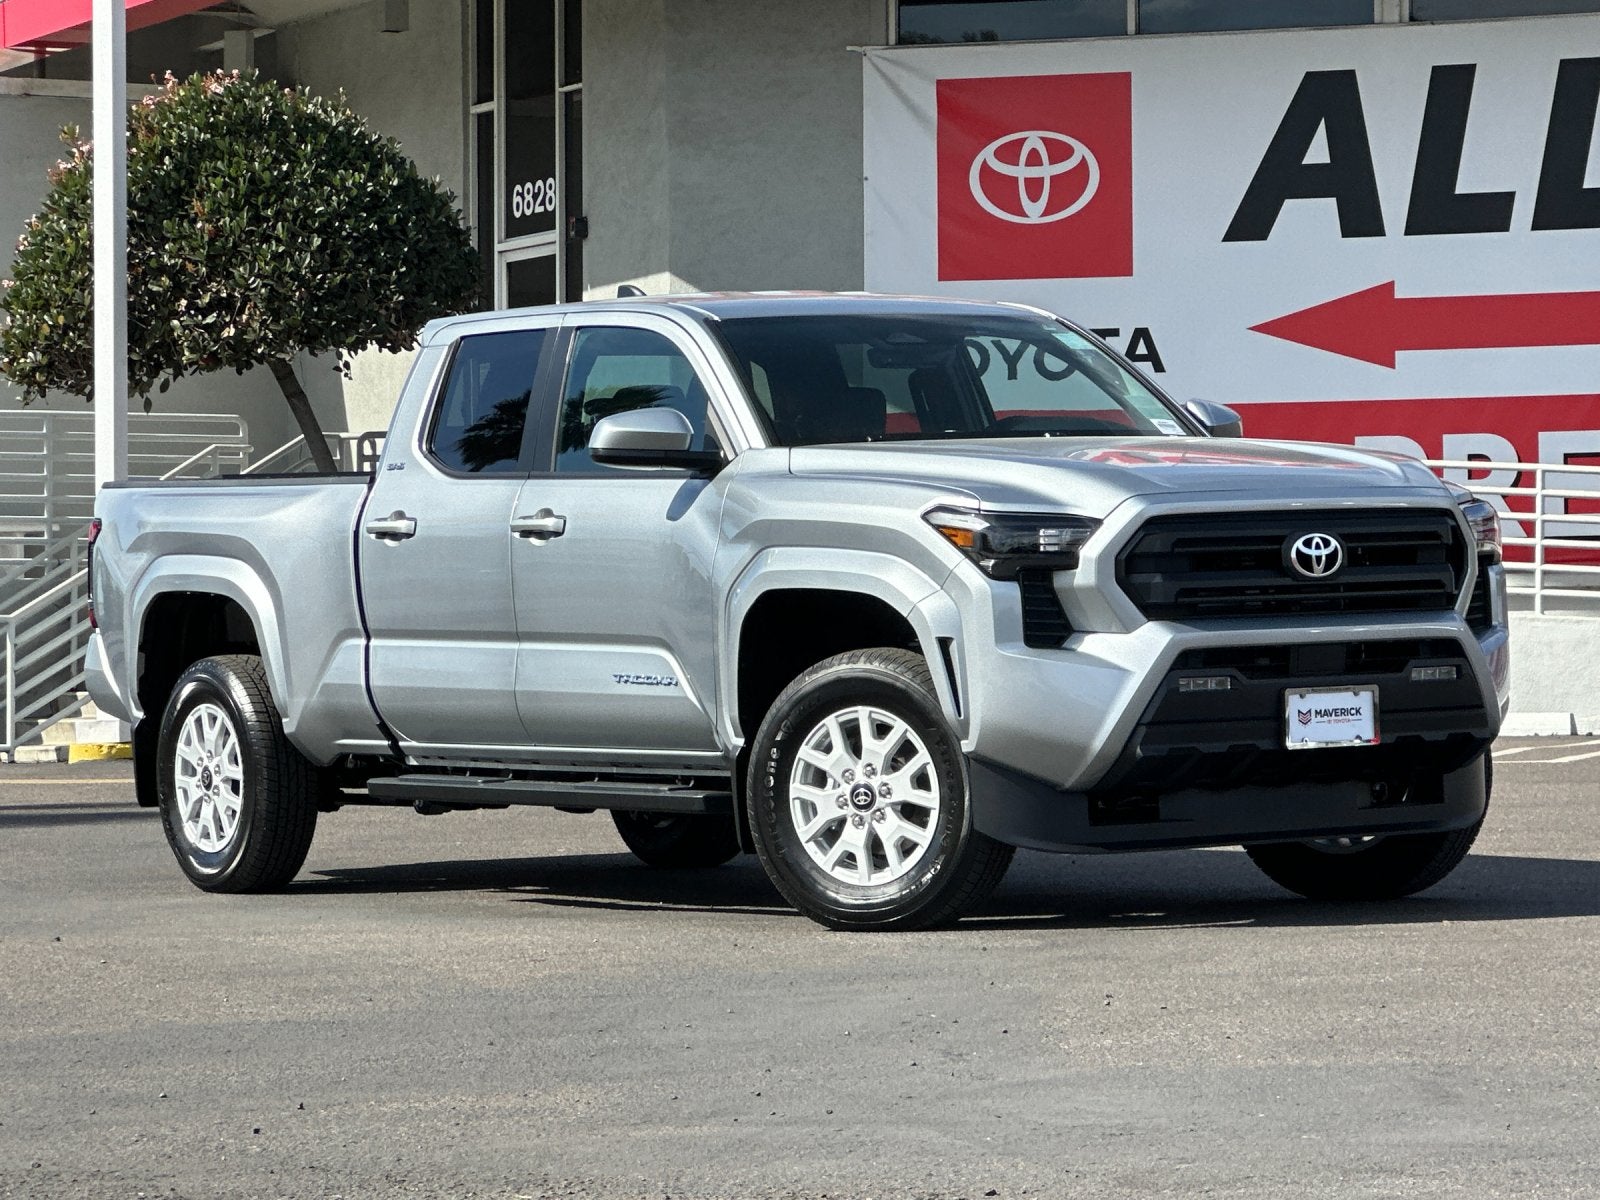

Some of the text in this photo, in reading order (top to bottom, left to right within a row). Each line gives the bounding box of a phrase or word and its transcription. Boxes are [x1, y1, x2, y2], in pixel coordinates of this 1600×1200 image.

[1221, 57, 1600, 242] ALL
[513, 177, 555, 218] 6828
[1355, 430, 1600, 538] RE
[1314, 706, 1362, 718] MAVERICK
